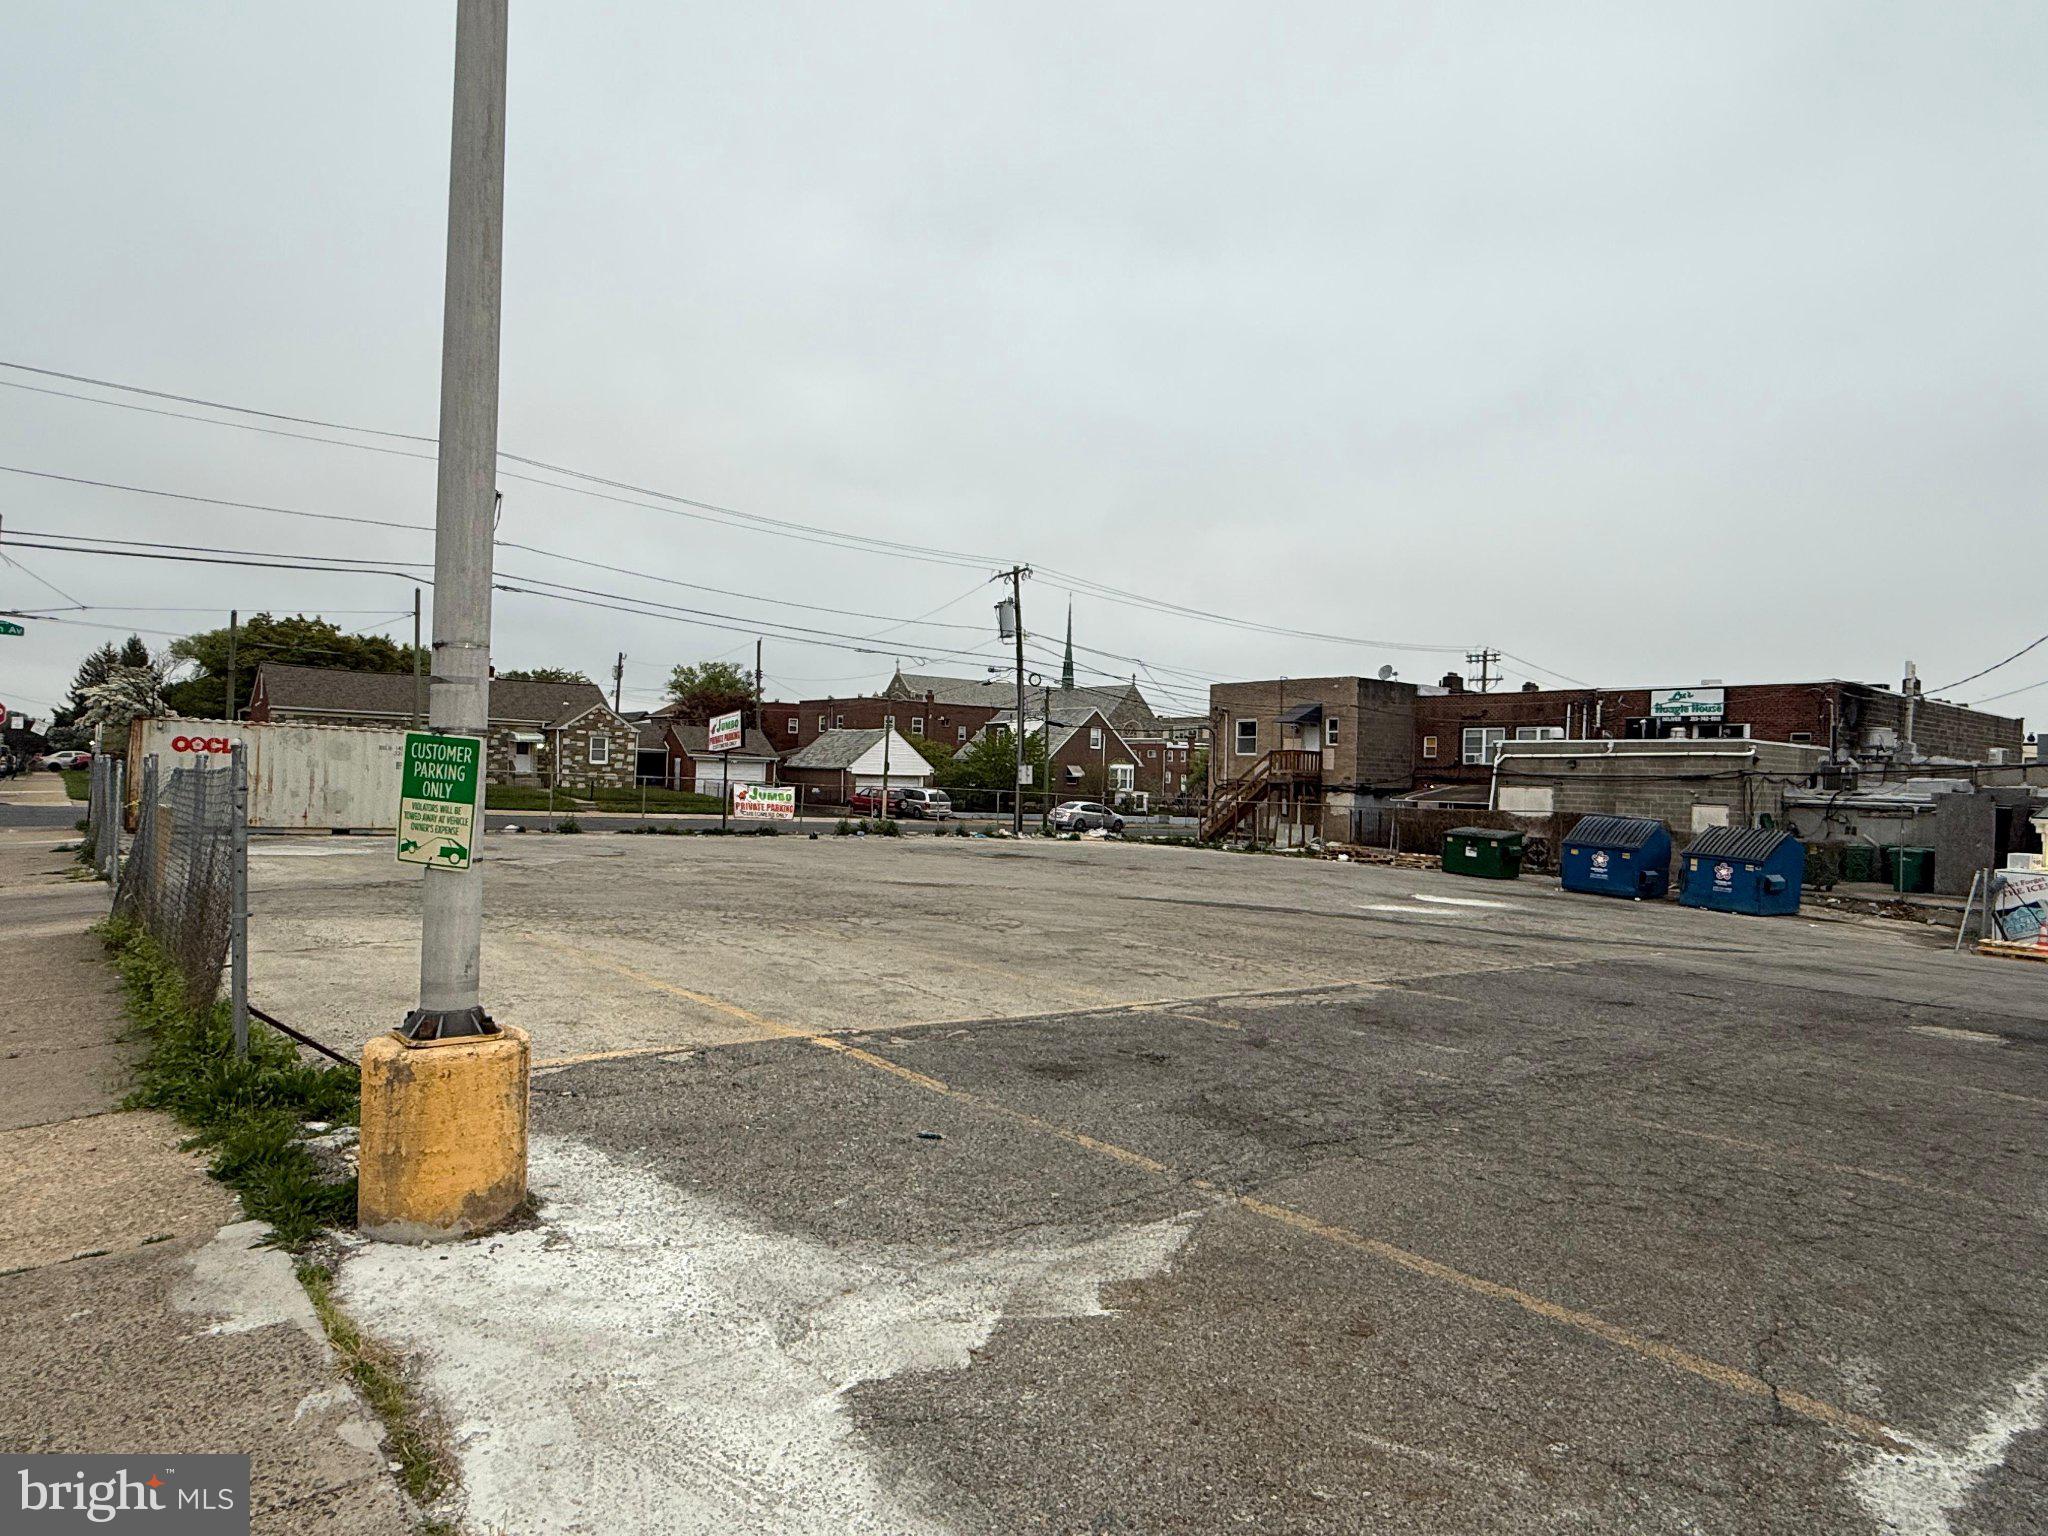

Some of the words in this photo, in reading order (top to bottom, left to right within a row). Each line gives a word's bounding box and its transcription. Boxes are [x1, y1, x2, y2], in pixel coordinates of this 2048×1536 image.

[1691, 703, 1722, 713] House
[171, 736, 232, 754] OOCL
[411, 742, 472, 763] CUSTOMER
[413, 761, 466, 782] PARKING
[422, 781, 453, 799] ONLY
[411, 802, 439, 813] VIOLATORS
[440, 804, 453, 815] WILL
[454, 806, 462, 815] BE
[735, 802, 765, 811] PRIVATE
[766, 803, 794, 813] PARKING
[404, 810, 422, 821] TOWED
[422, 813, 437, 823] AWAY
[438, 815, 446, 823] AT
[446, 816, 469, 827] VEHICLE
[410, 822, 434, 833] OWNER'S
[434, 825, 459, 835] EXPENSE
[2020, 877, 2046, 886] Forget
